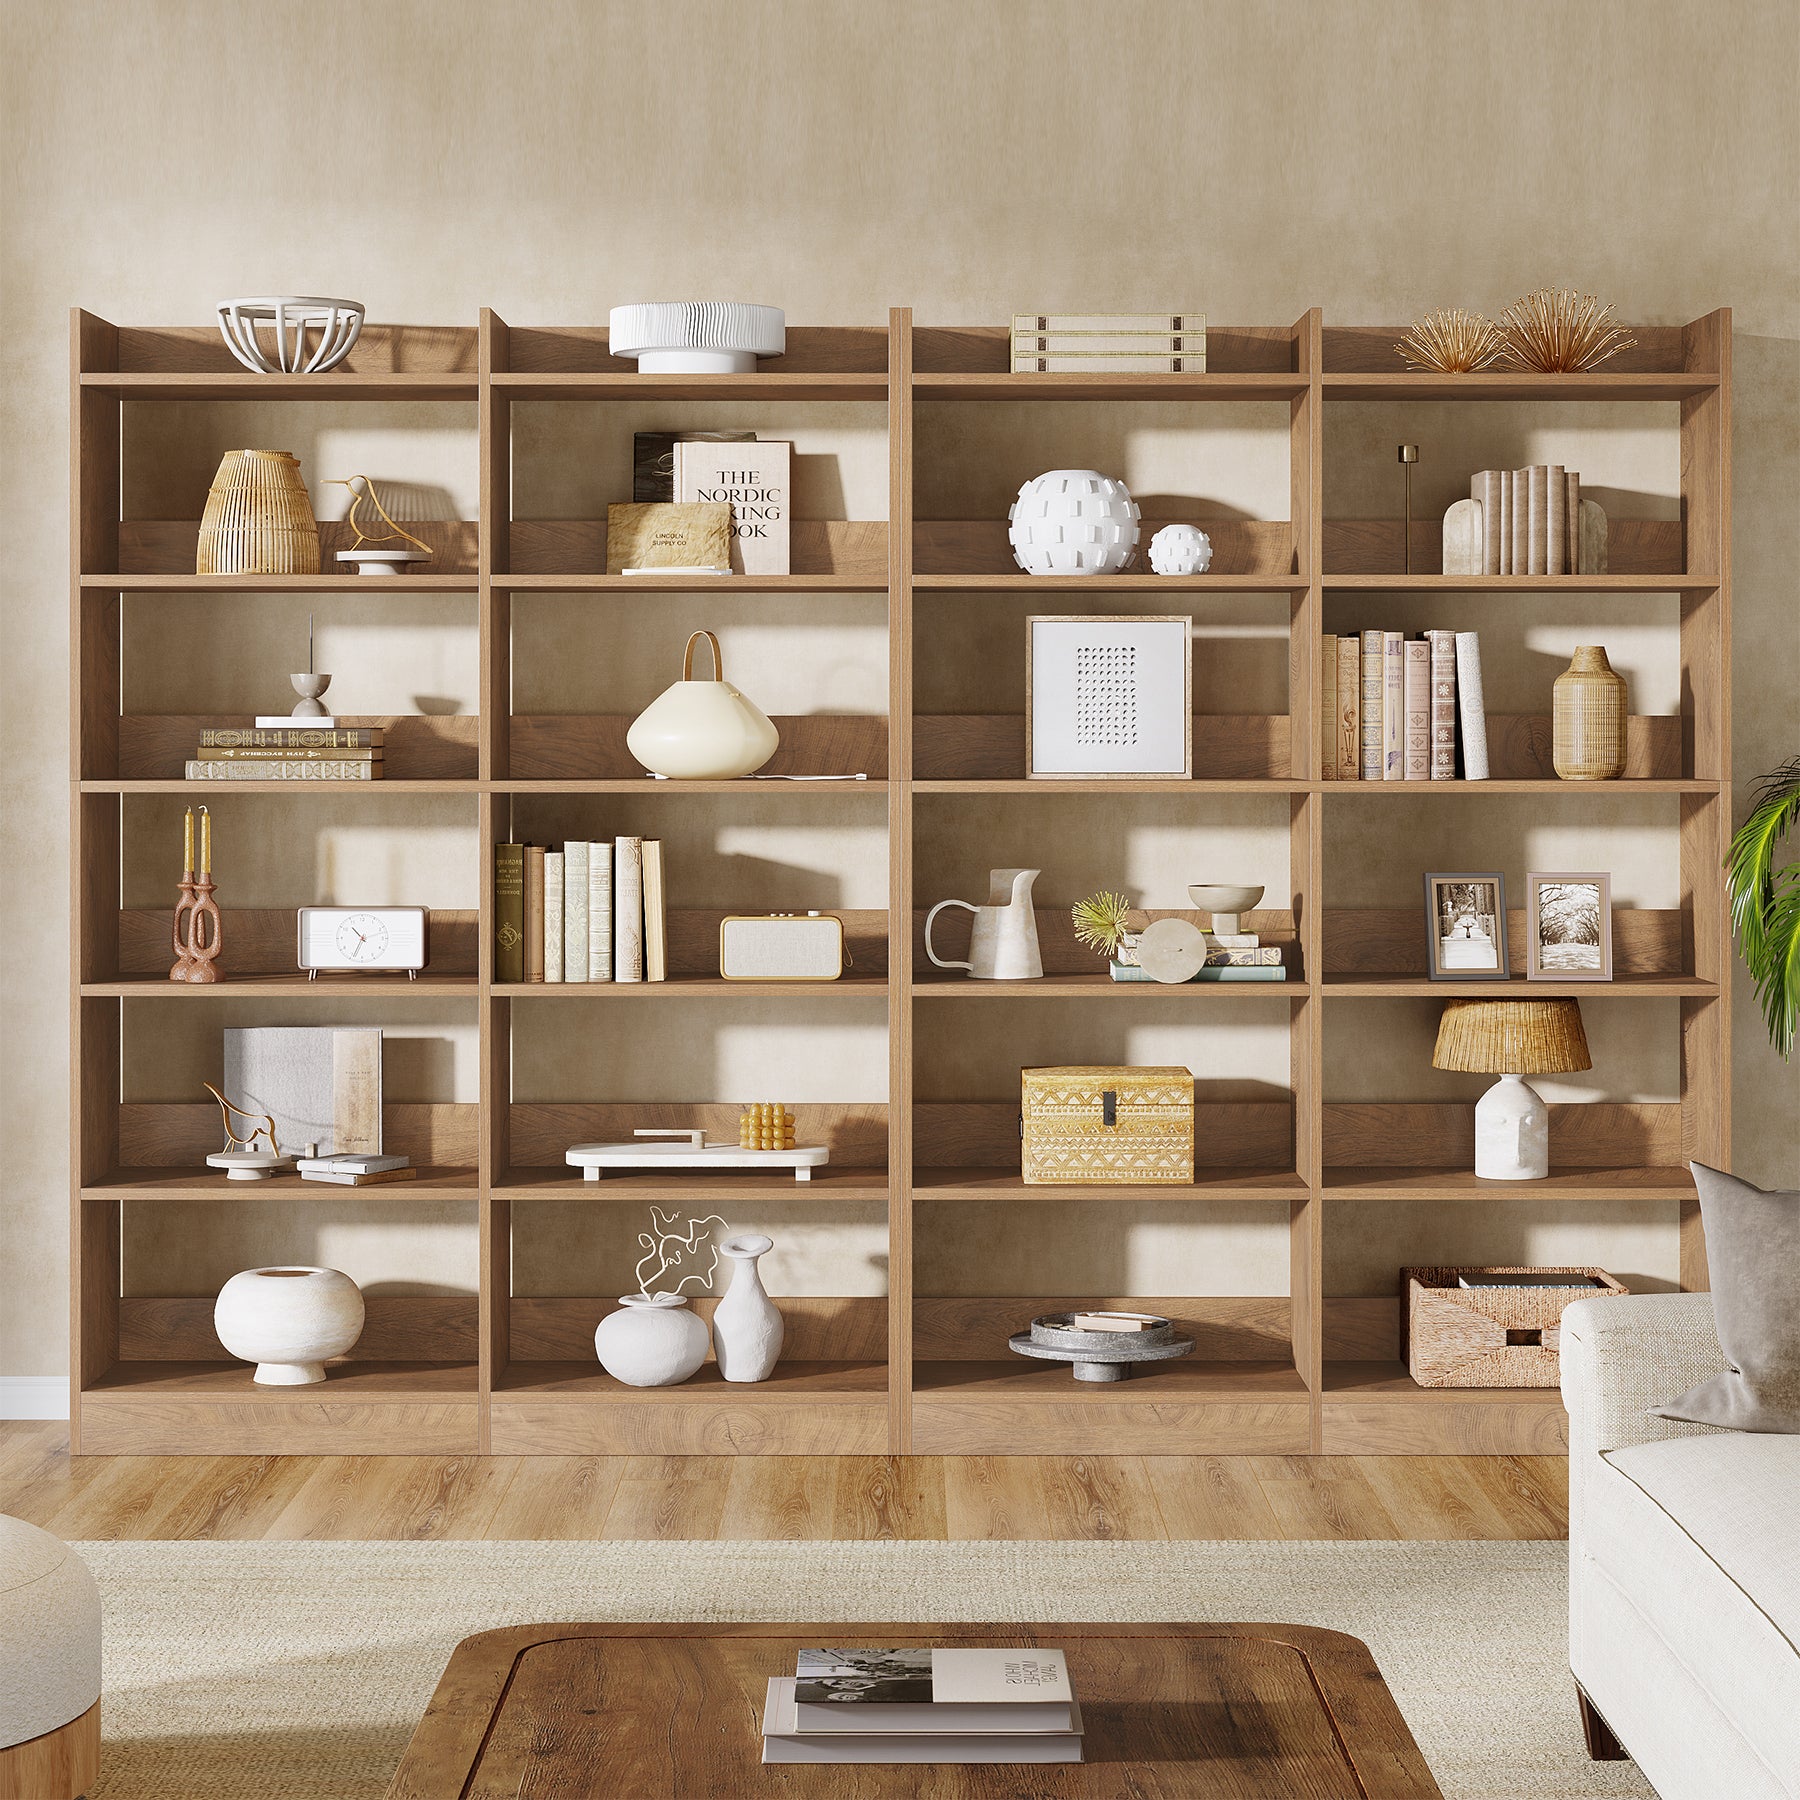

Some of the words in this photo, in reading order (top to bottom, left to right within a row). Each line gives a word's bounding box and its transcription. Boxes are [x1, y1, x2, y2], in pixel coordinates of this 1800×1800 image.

[716, 471, 761, 485] THE
[697, 489, 781, 503] NORDIC
[730, 506, 781, 521] KING
[730, 525, 768, 538] OOK
